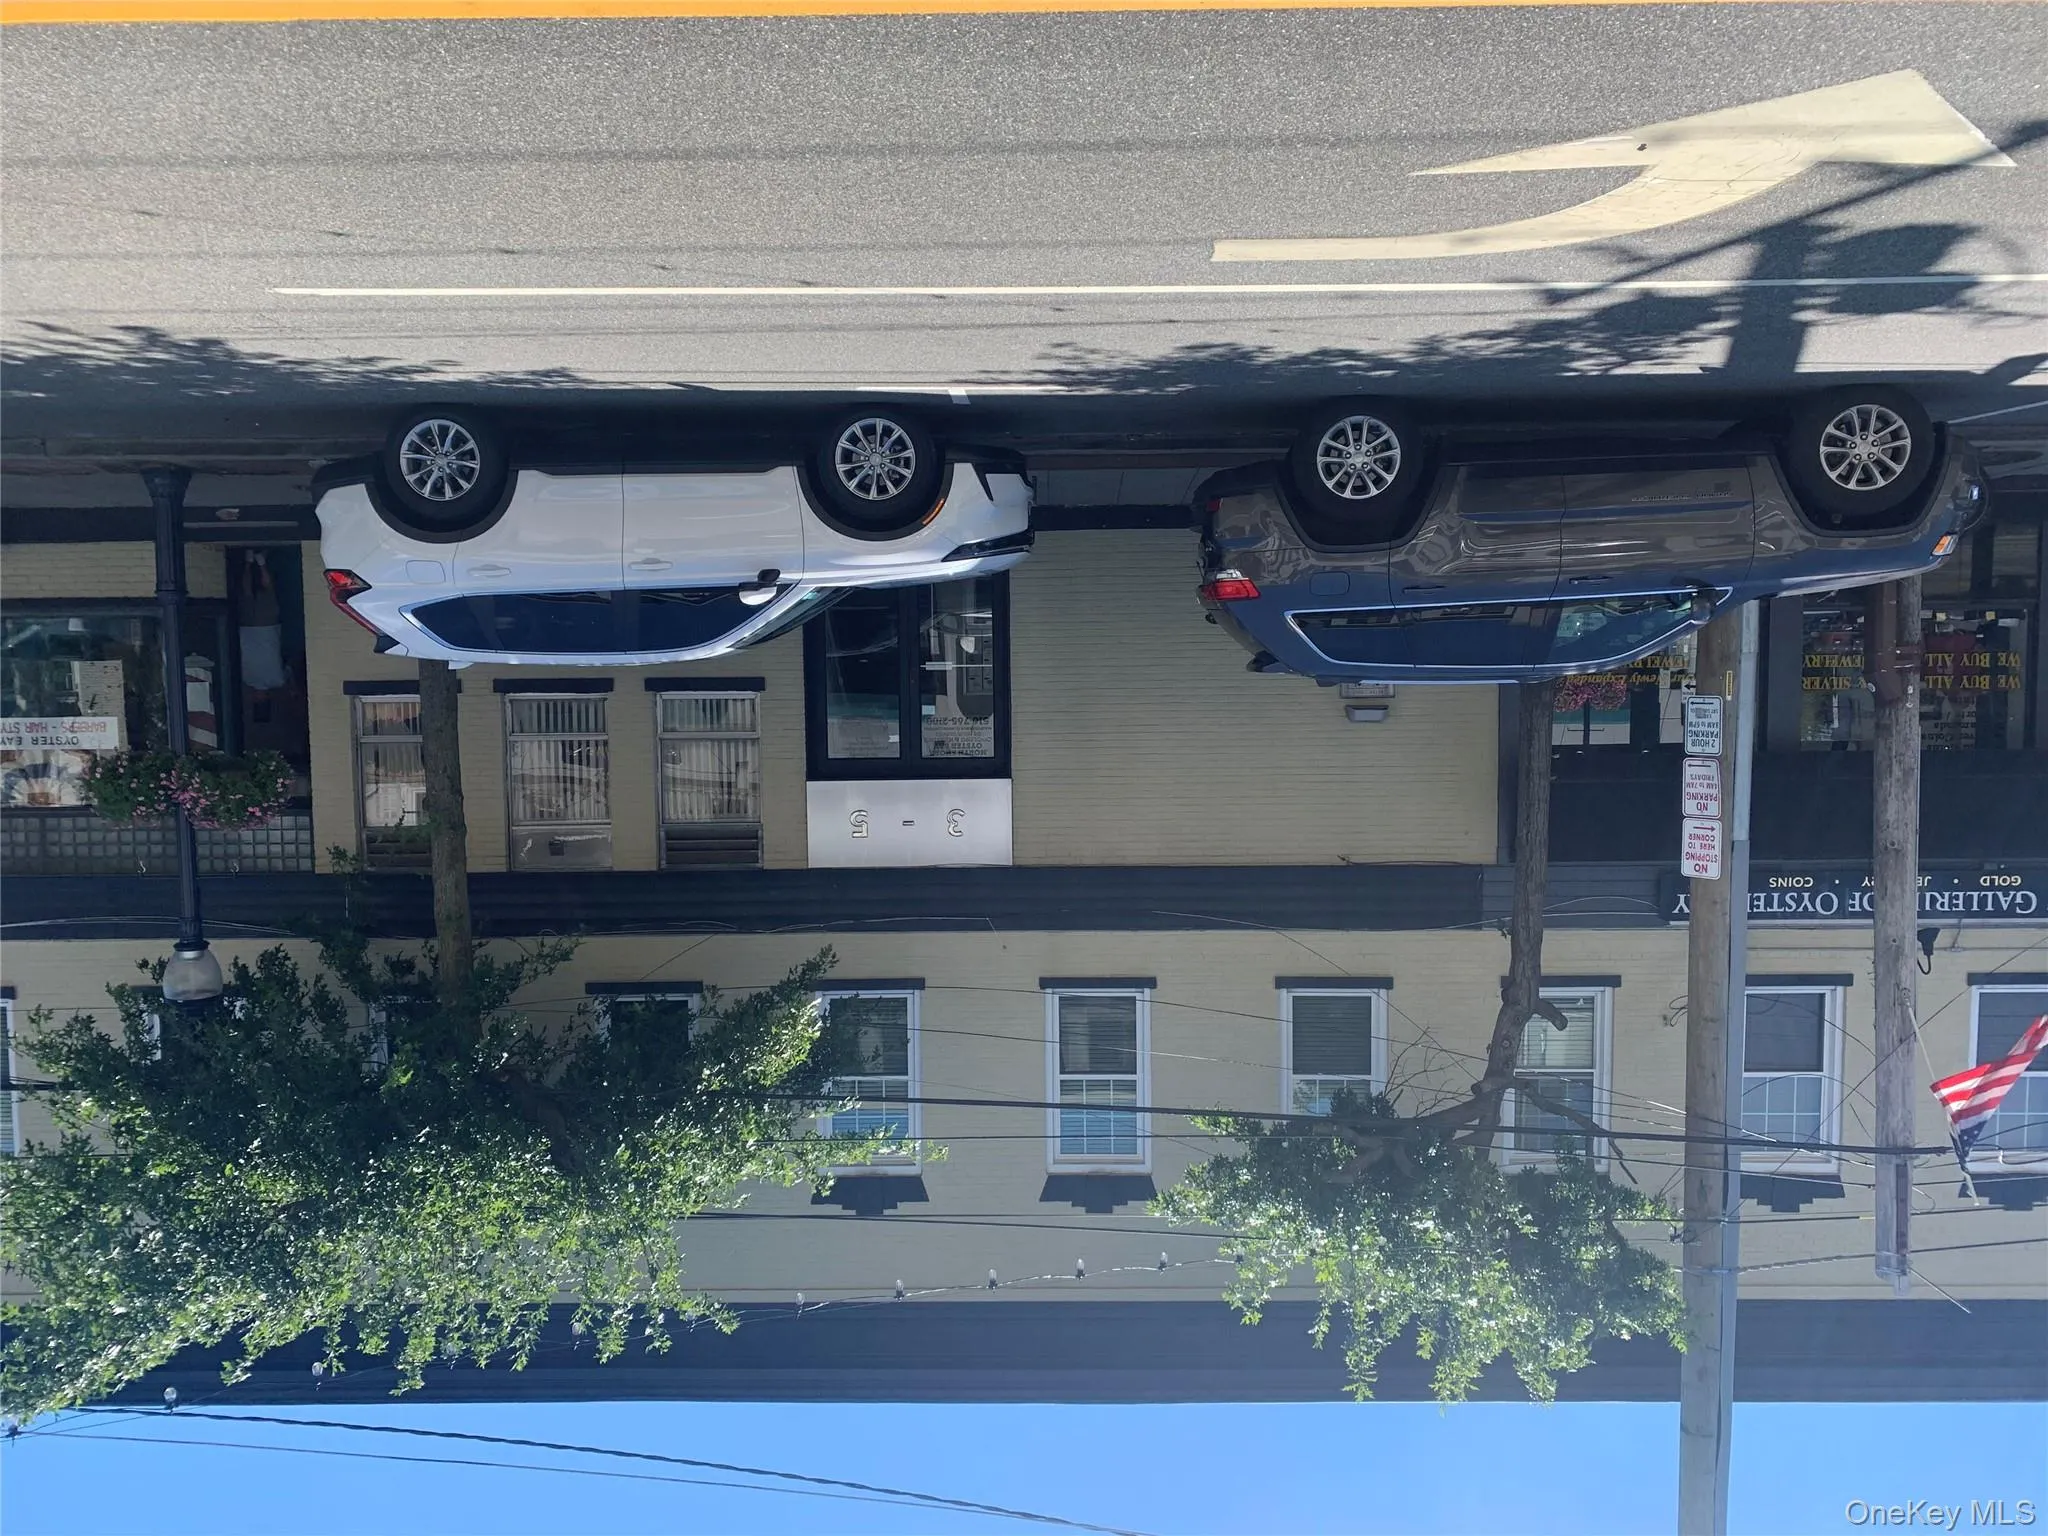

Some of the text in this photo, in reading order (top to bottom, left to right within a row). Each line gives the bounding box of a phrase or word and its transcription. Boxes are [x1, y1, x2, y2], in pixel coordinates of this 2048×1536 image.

[1924, 653, 1954, 667] ALL
[1960, 652, 1990, 667] BUY
[1997, 652, 2020, 667] WE
[1802, 677, 1851, 690] SILVER
[1924, 675, 1954, 689] ALL
[1960, 675, 1990, 690] BUY
[1997, 674, 2020, 689] WE
[25, 722, 48, 733] HAIR
[1688, 730, 1719, 739] PARKING
[31, 736, 79, 746] OYSTER
[1691, 739, 1716, 748] 2 HOUR
[1690, 774, 1714, 782] FRIDAYS
[1686, 792, 1718, 802] PARKING
[1696, 802, 1708, 811] NO
[850, 810, 869, 839] 5
[946, 809, 965, 837] 3
[1689, 833, 1715, 842] CORNER
[1700, 843, 1715, 851] HERE
[1685, 852, 1718, 863] STOPPING
[1694, 863, 1708, 874] NO
[1769, 876, 1814, 887] COINS
[1980, 875, 2022, 887] GOLD
[1917, 890, 2037, 914] GALLERI
